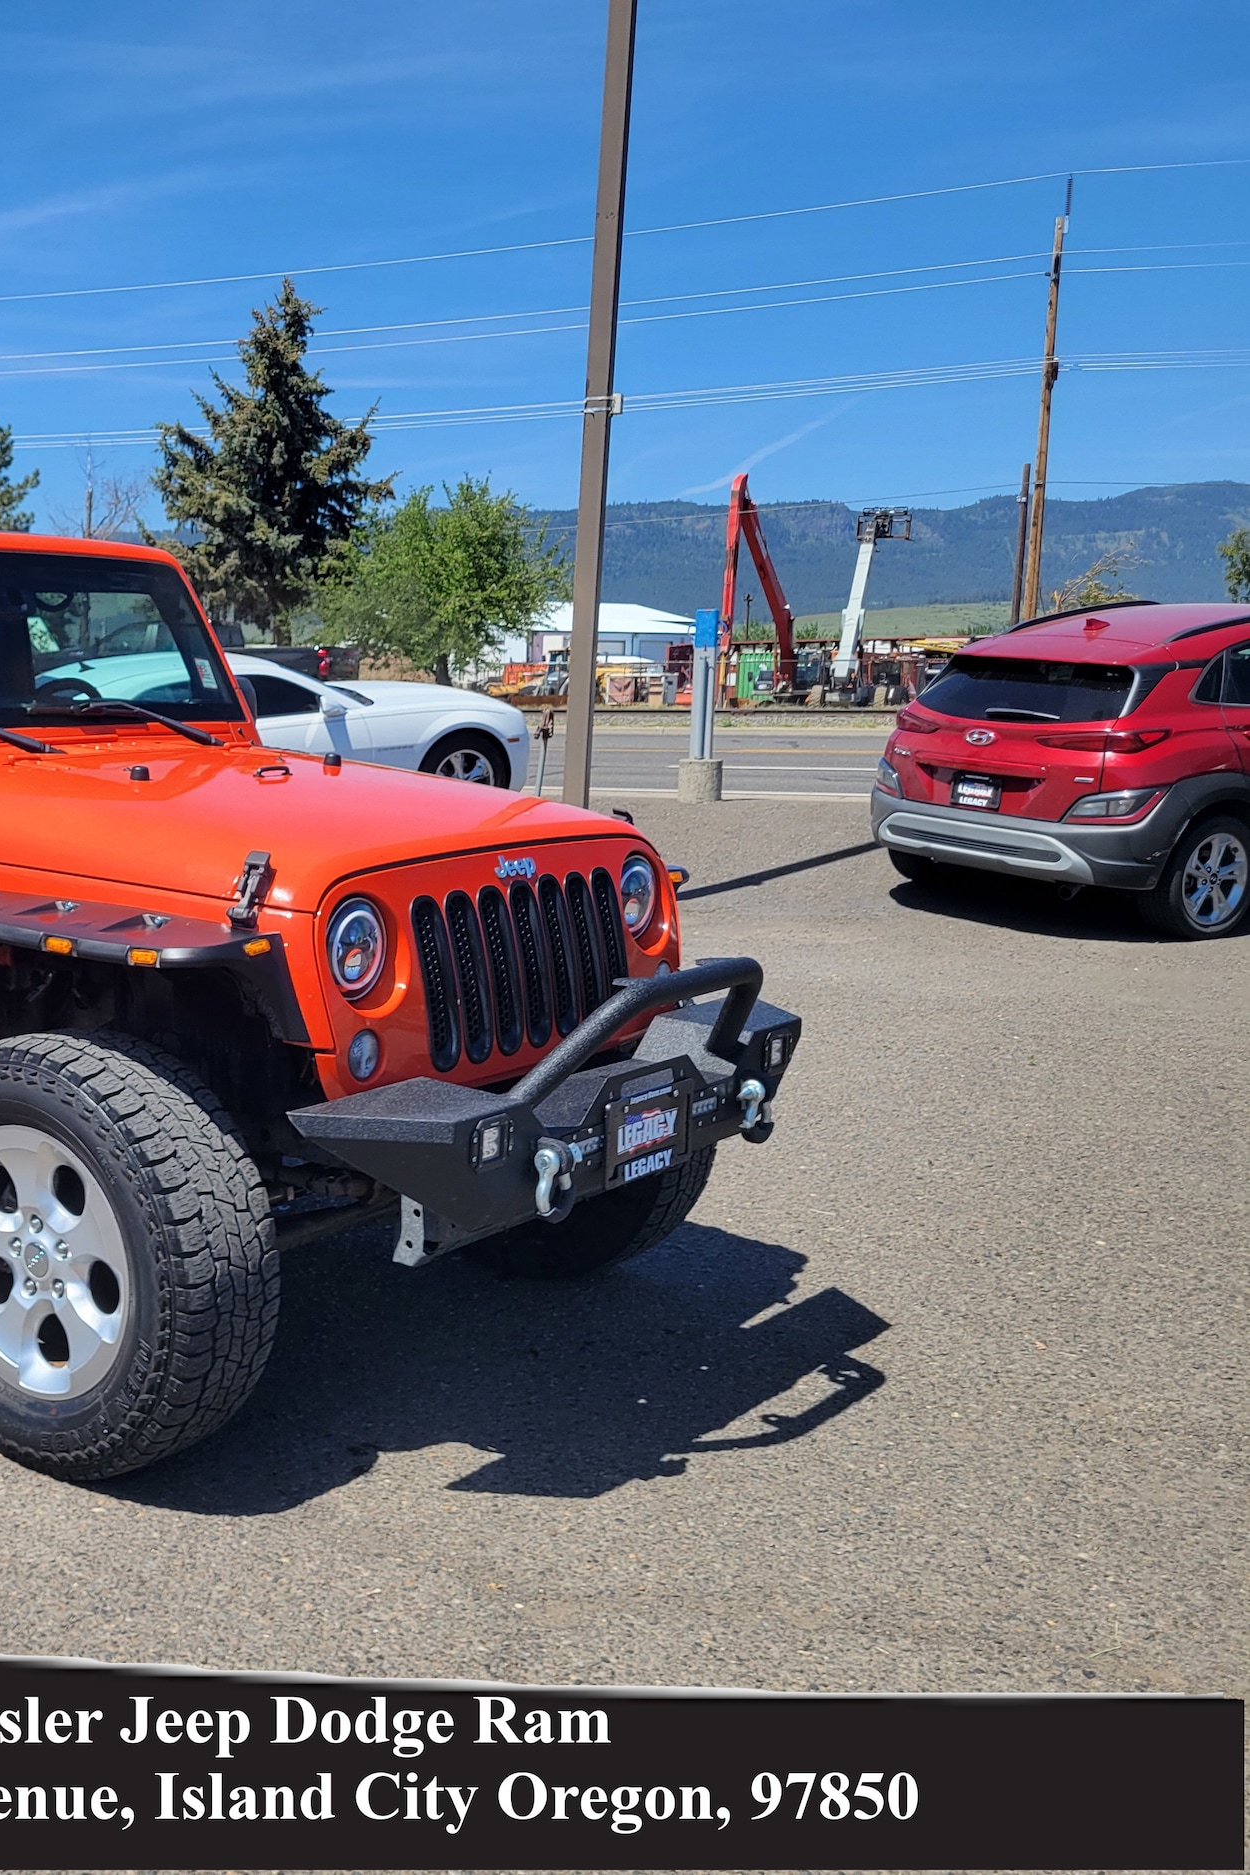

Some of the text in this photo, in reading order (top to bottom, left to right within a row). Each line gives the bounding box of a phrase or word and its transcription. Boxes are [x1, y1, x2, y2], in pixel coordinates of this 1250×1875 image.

[494, 855, 536, 879] Jeep
[617, 1109, 678, 1153] LEGACY
[624, 1149, 673, 1182] LEGACY
